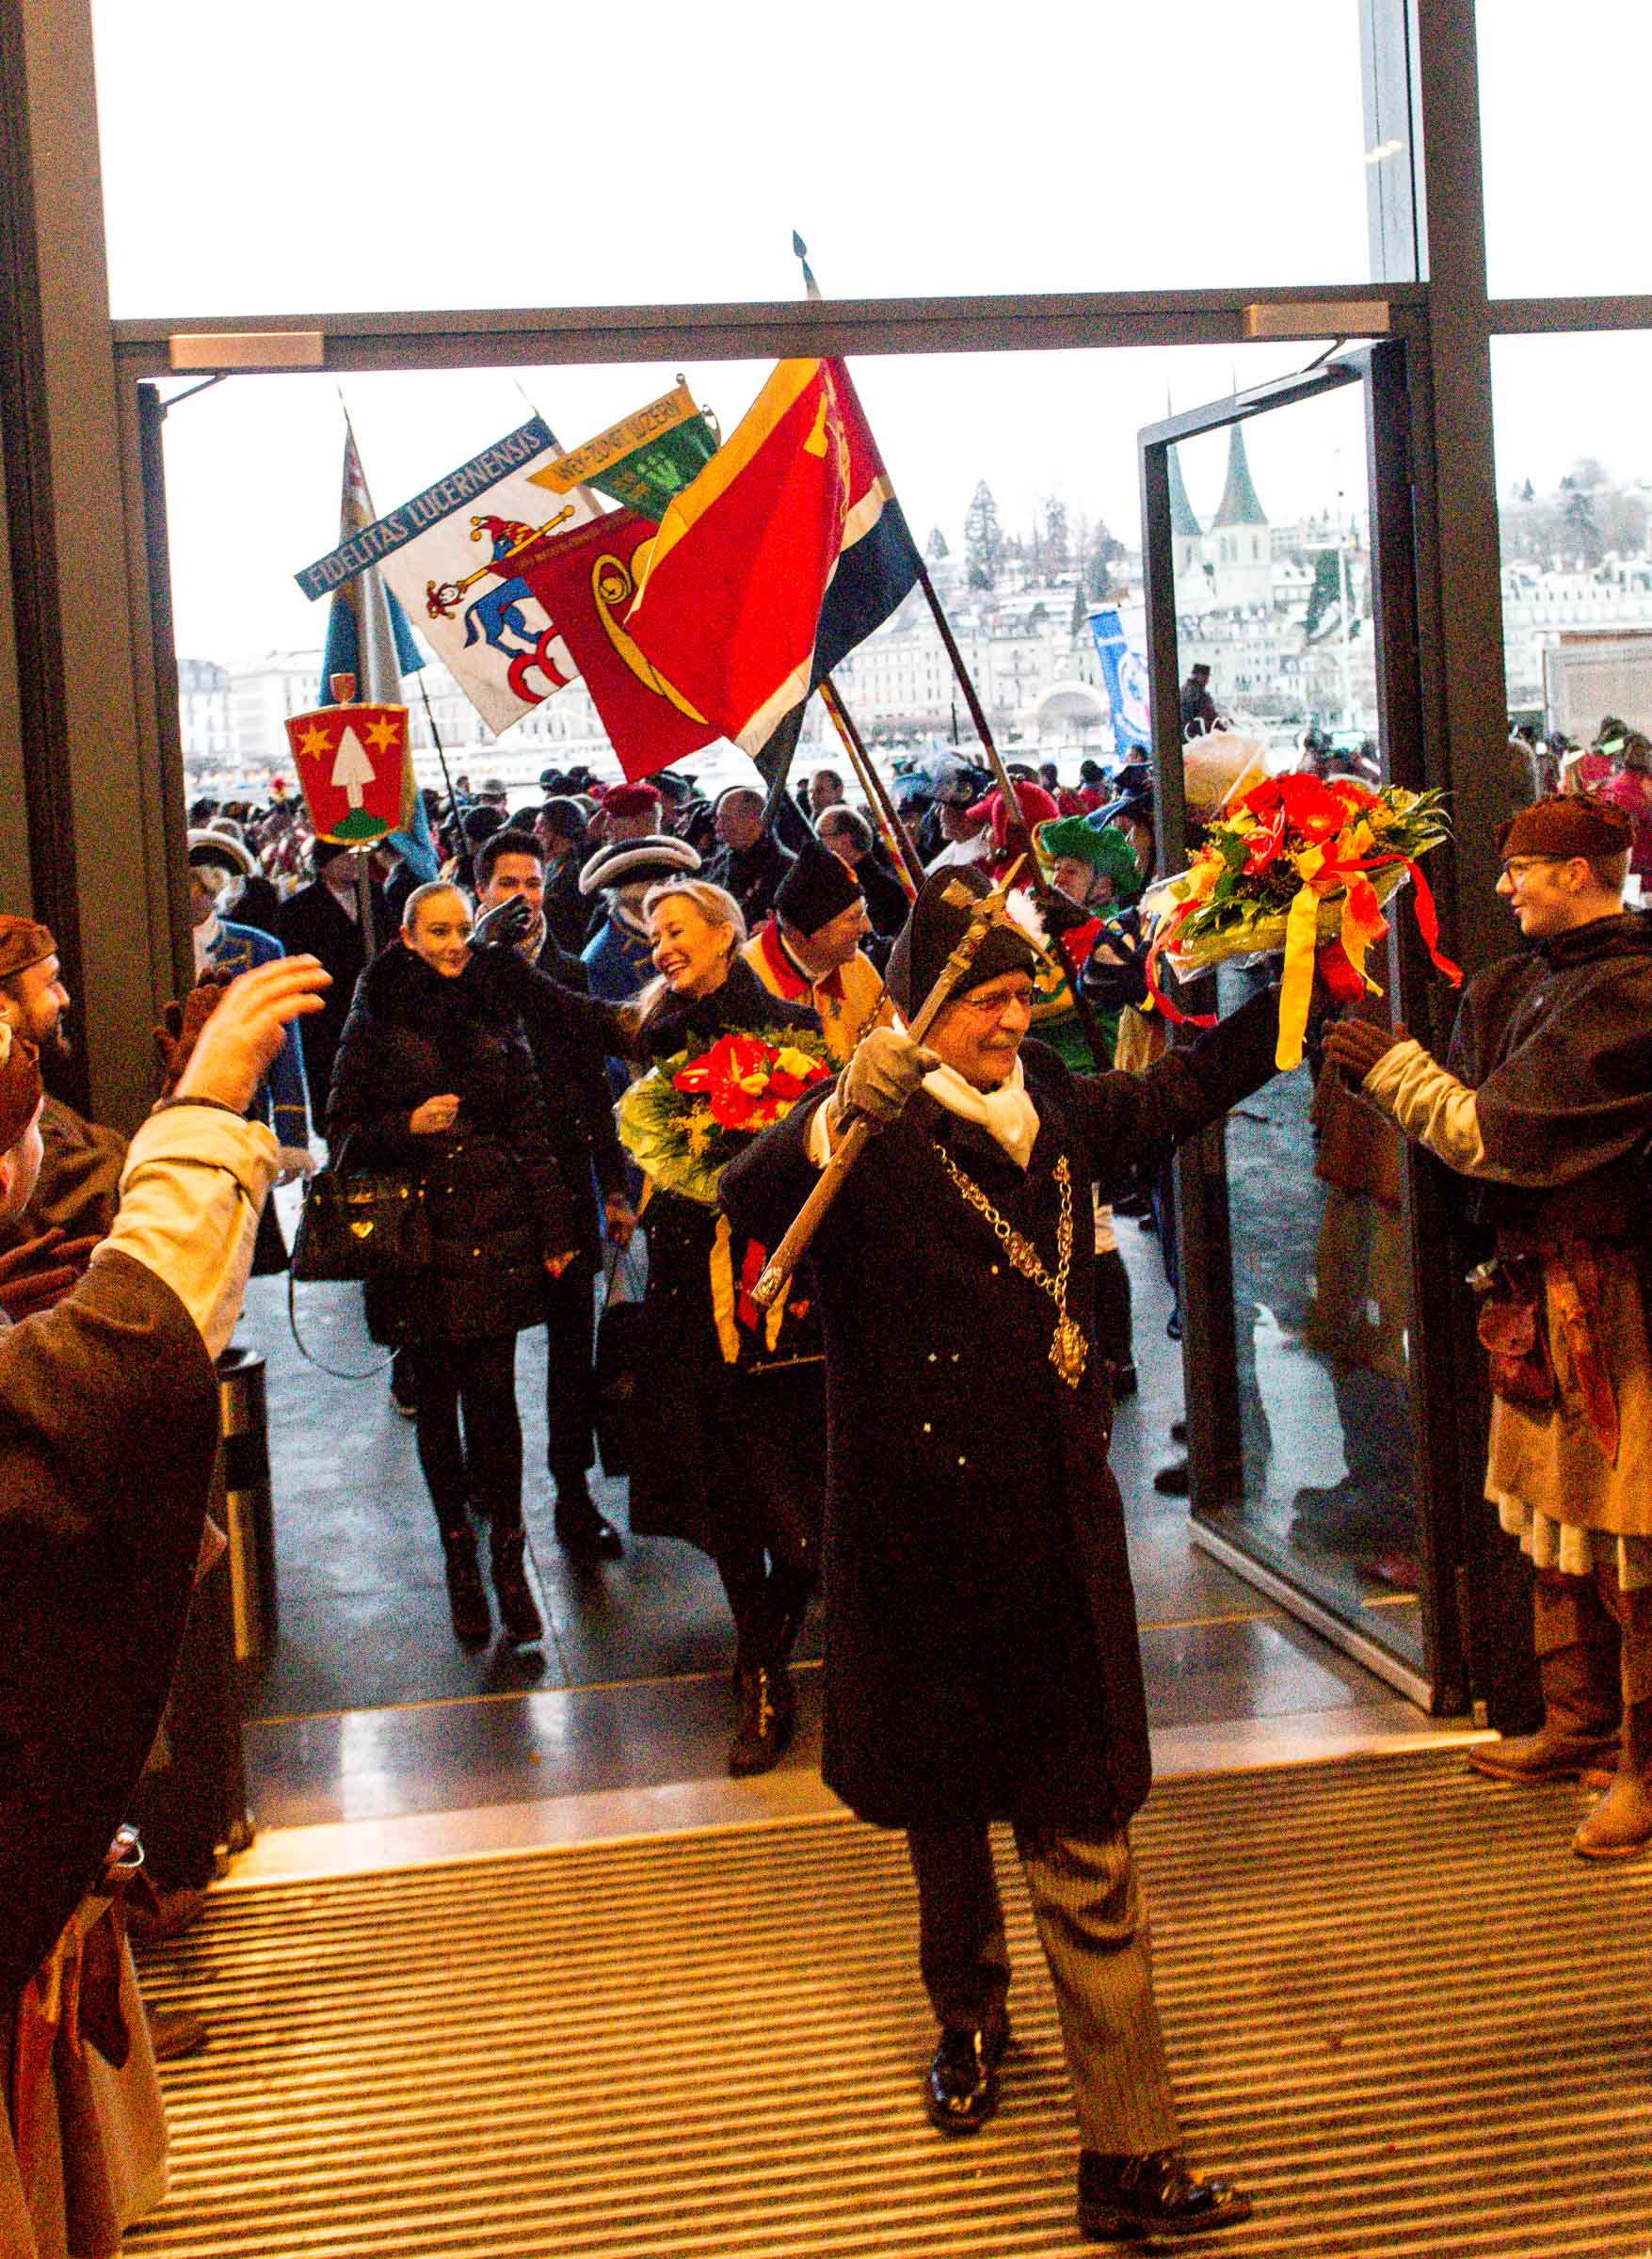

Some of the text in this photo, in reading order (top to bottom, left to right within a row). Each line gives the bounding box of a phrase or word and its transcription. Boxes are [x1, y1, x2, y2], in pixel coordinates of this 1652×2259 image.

[626, 395, 682, 440] LUZERN
[309, 512, 409, 589] FIDELITAS
[406, 428, 542, 526] LUCERNENSIS
